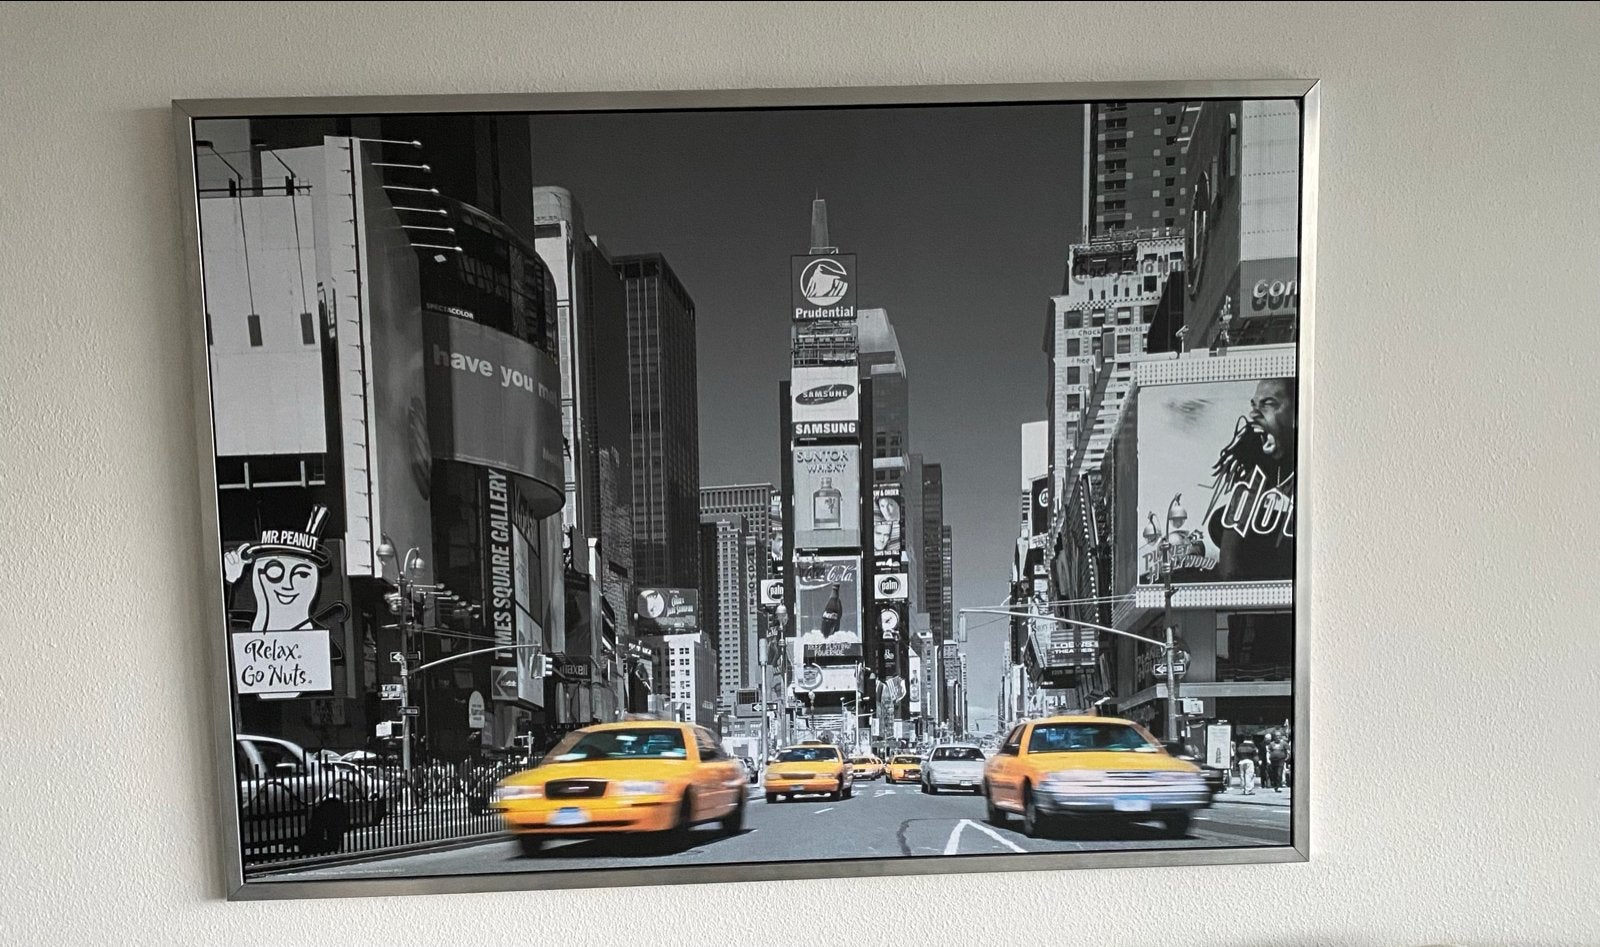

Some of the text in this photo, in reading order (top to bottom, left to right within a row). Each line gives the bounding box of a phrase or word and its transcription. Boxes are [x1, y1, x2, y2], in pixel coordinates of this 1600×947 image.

[796, 306, 854, 319] Prudential
[433, 344, 533, 393] have you
[802, 390, 848, 398] SAMSUNG
[795, 422, 856, 435] SAMSUNG
[487, 468, 510, 543] GALLERY
[261, 530, 319, 551] MR. PEANUT
[492, 544, 513, 608] SQUARE
[881, 580, 898, 592] palm
[493, 611, 513, 660] TIMES
[244, 639, 303, 662] Relax.
[241, 664, 313, 687] Go Nuts.
